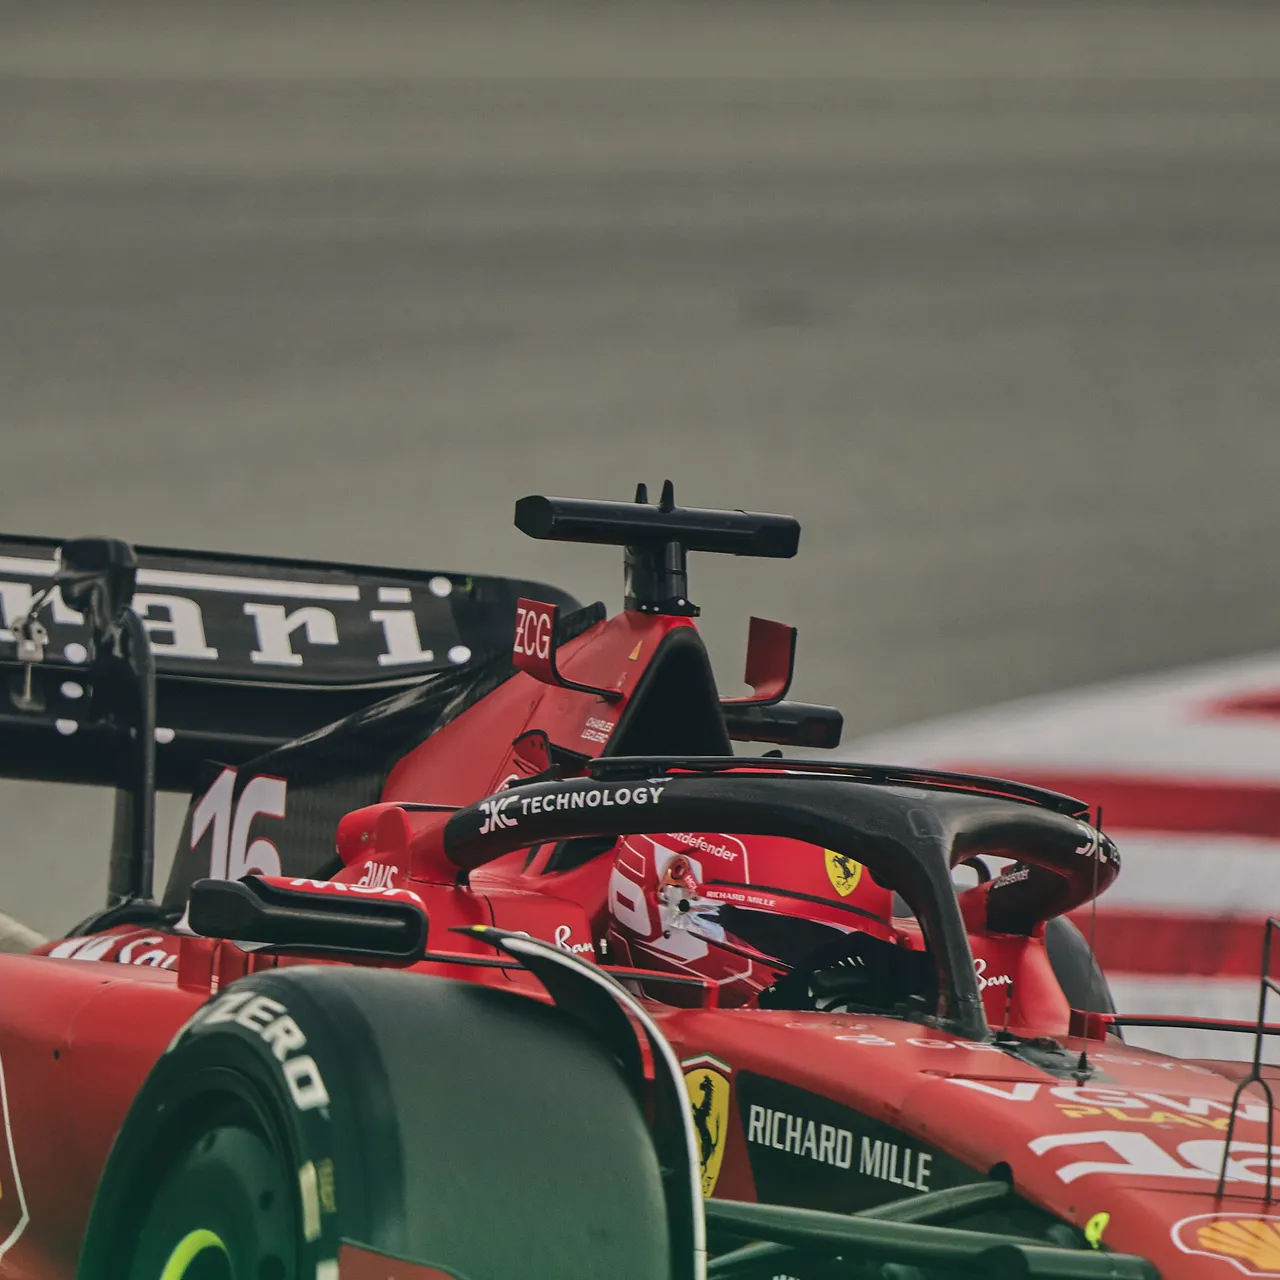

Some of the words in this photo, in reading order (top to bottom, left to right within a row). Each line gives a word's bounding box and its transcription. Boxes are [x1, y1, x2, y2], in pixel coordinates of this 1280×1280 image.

[513, 607, 553, 660] ZCG
[190, 766, 288, 881] 16
[520, 786, 665, 816] TECHNOLOGY
[357, 860, 399, 889] aws
[705, 890, 746, 902] RICHARD
[747, 895, 777, 908] MILLE
[204, 991, 331, 1112] ZERO
[943, 1078, 1270, 1123] VGW
[1056, 1103, 1232, 1131] PLAY
[748, 1102, 854, 1169] RICHARD
[860, 1134, 933, 1194] MILLE
